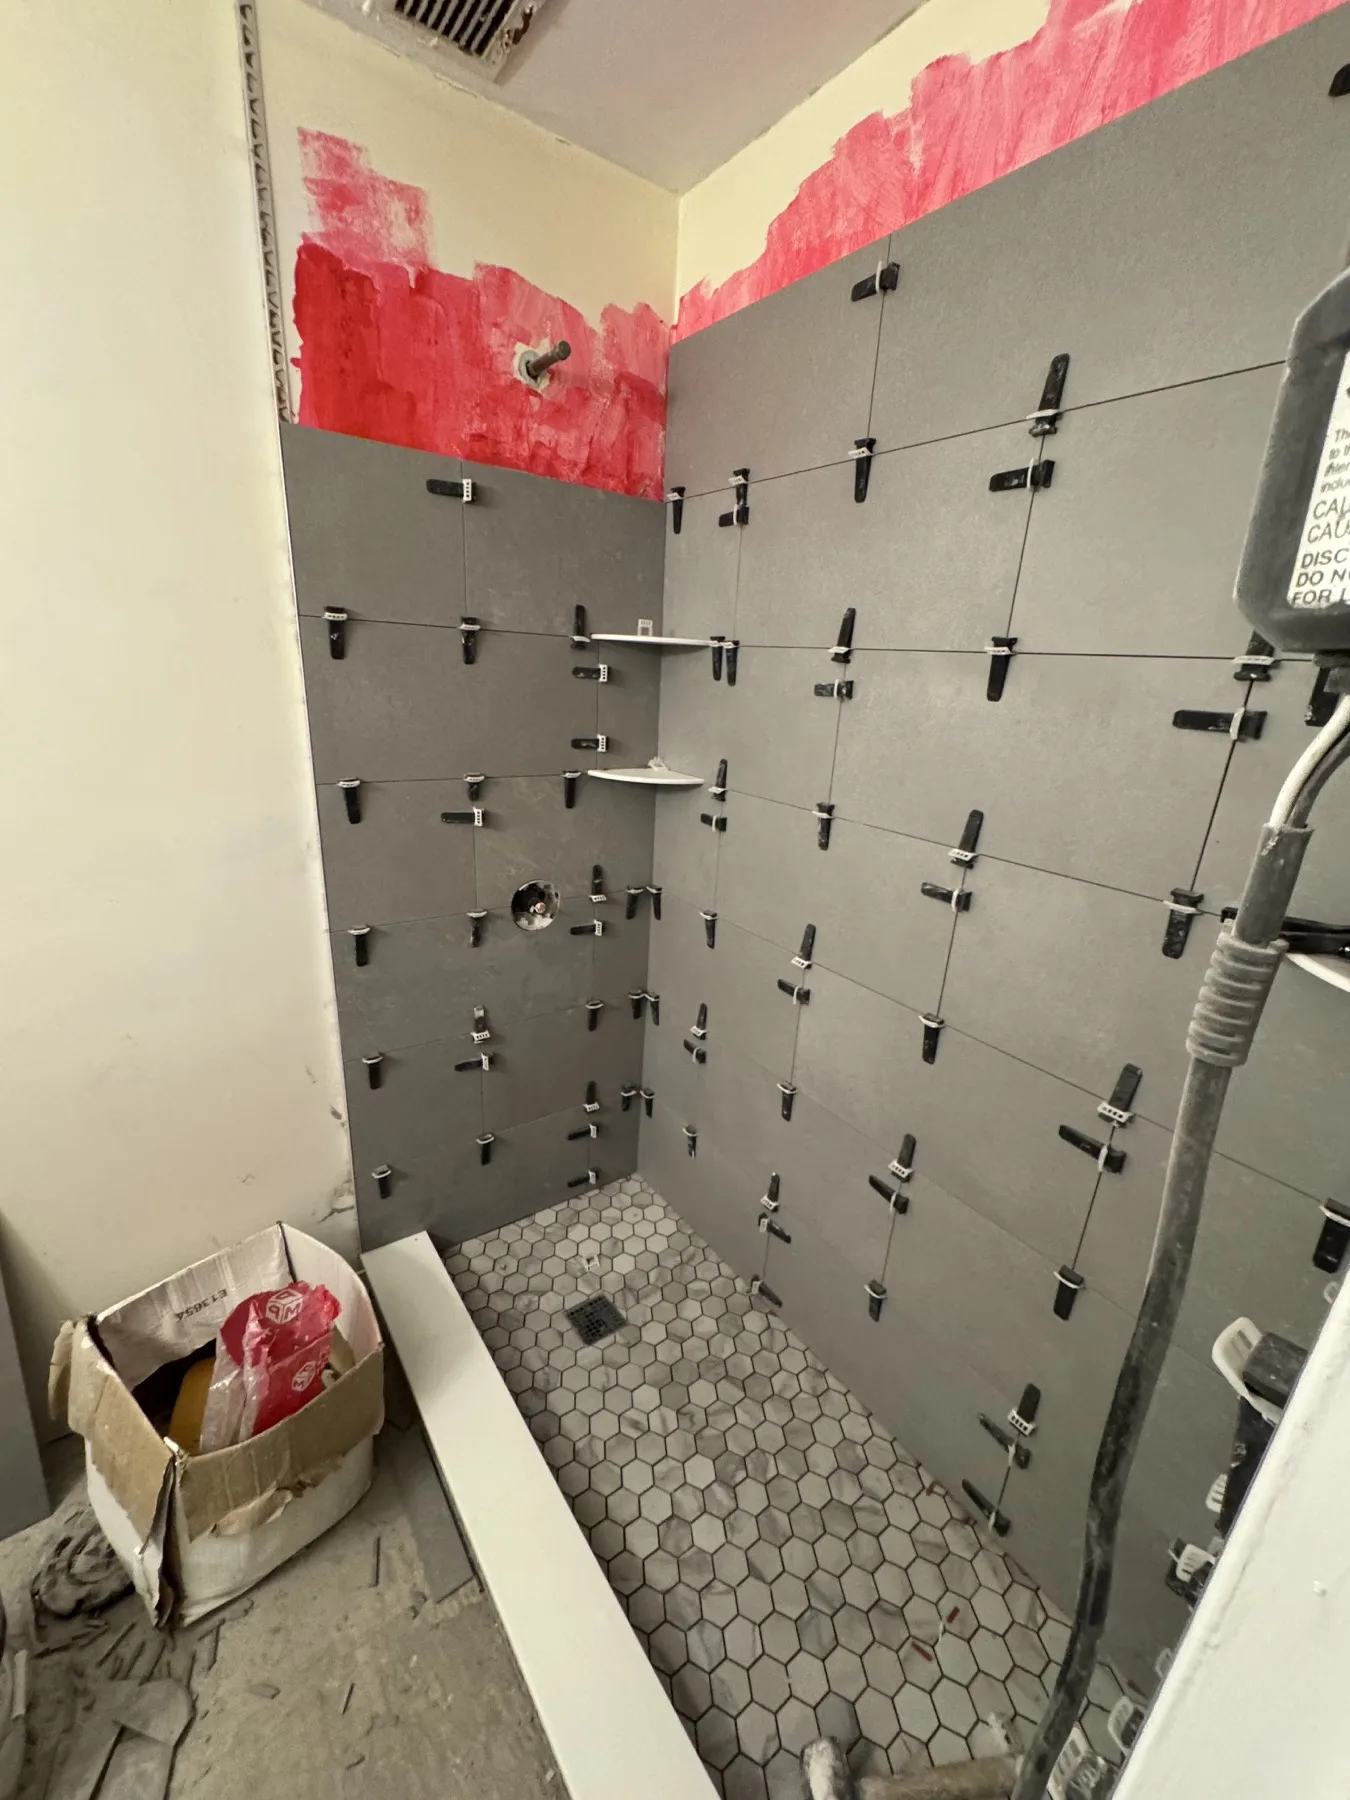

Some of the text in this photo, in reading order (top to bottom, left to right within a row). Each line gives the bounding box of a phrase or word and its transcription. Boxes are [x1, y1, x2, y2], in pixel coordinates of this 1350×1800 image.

[1295, 568, 1350, 588] DO N
[1292, 589, 1332, 605] FOR
